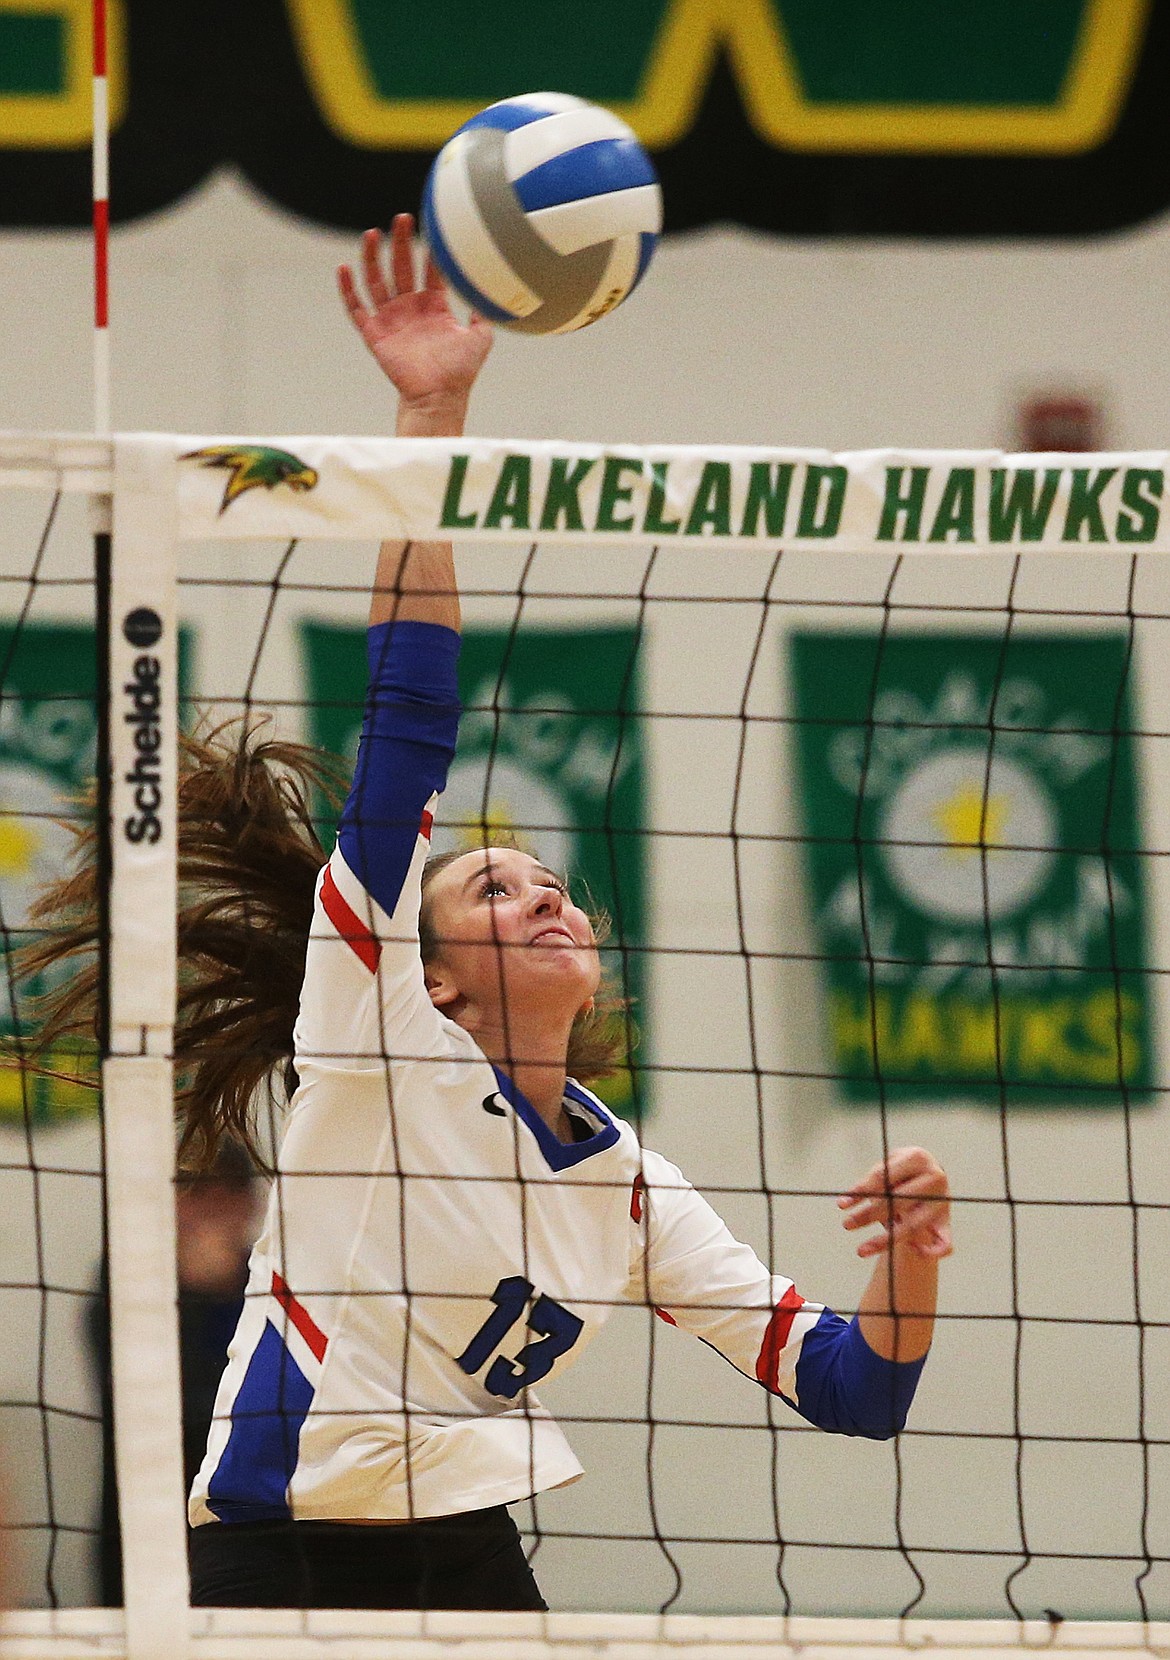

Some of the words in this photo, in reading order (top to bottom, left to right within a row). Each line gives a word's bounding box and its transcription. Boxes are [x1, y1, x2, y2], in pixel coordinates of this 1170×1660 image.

[439, 455, 846, 539] LAKELAND
[877, 467, 1165, 543] HAWKS
[124, 655, 162, 845] Schelde
[454, 1275, 585, 1399] 13
